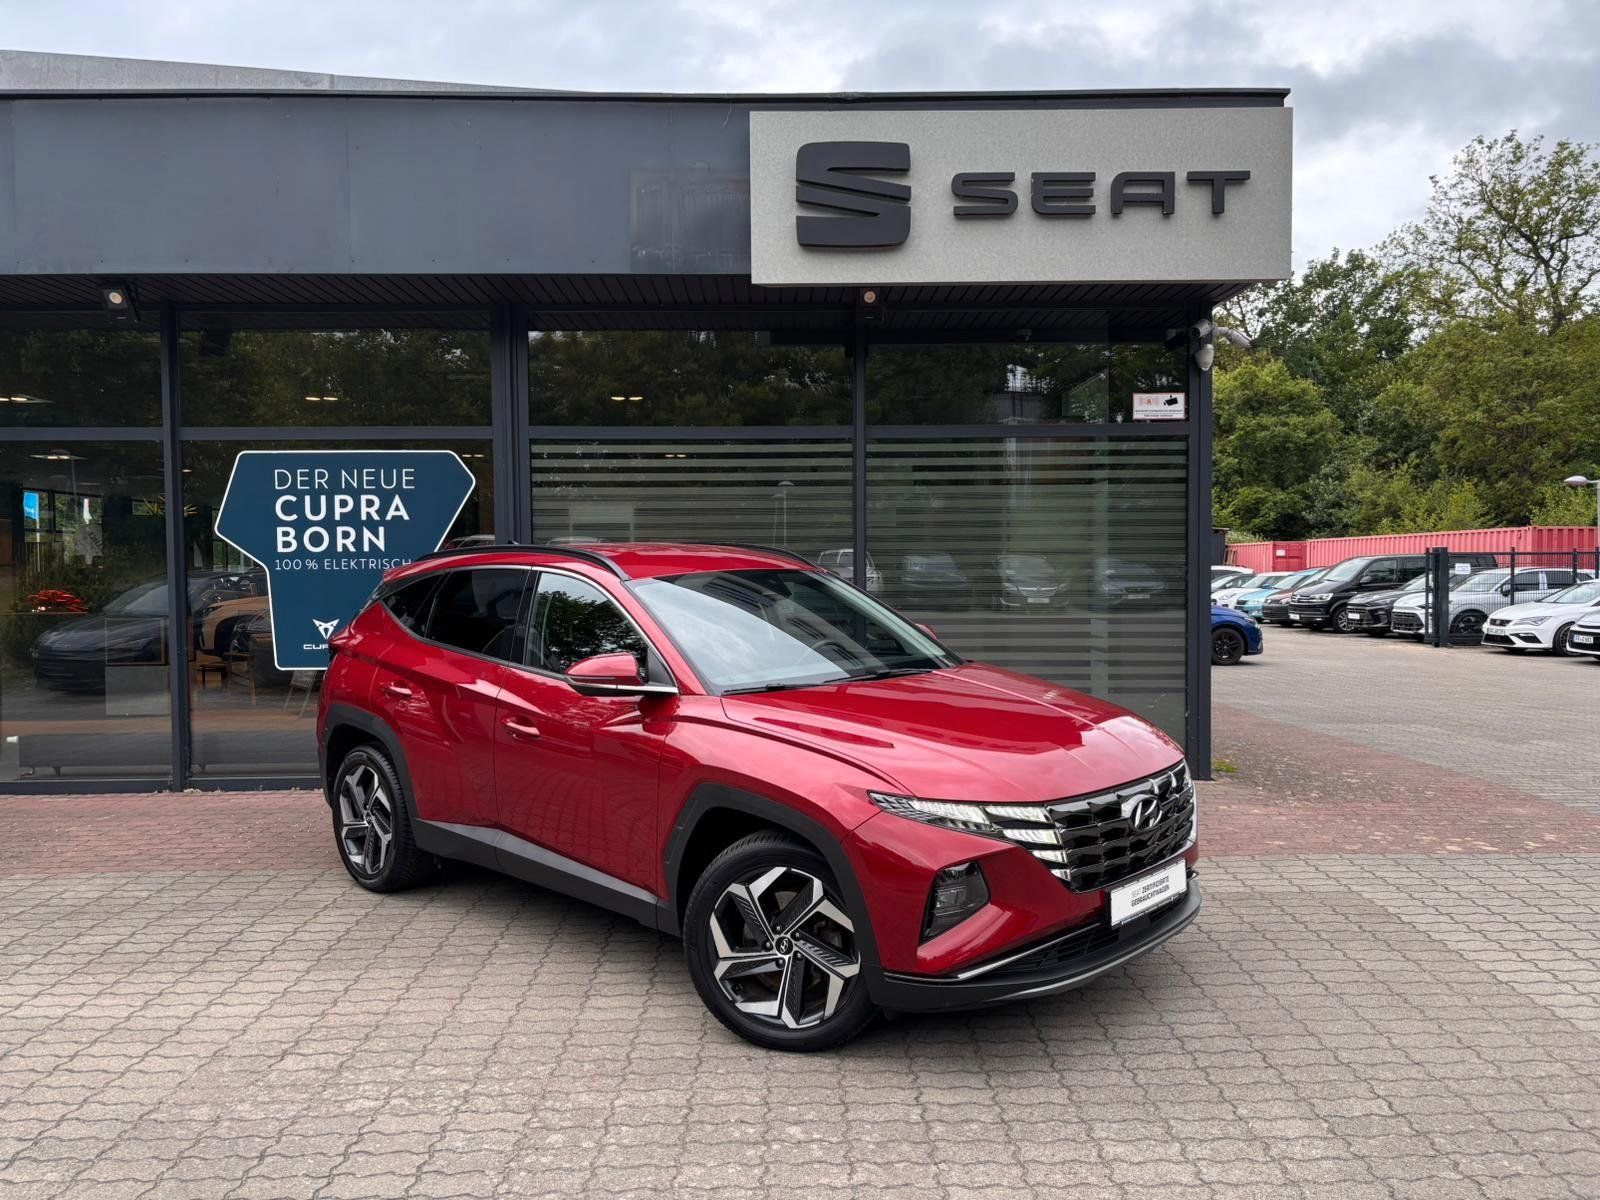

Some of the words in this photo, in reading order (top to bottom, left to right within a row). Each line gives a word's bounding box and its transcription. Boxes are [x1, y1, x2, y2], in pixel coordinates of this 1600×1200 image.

[951, 170, 1251, 217] SEAT
[274, 468, 329, 489] DER
[341, 468, 416, 489] NEUE
[275, 494, 410, 521] CUPRA
[276, 525, 386, 553] BORN
[274, 558, 302, 571] 100
[305, 558, 319, 570] %
[324, 558, 412, 570] ELEKTRISCH
